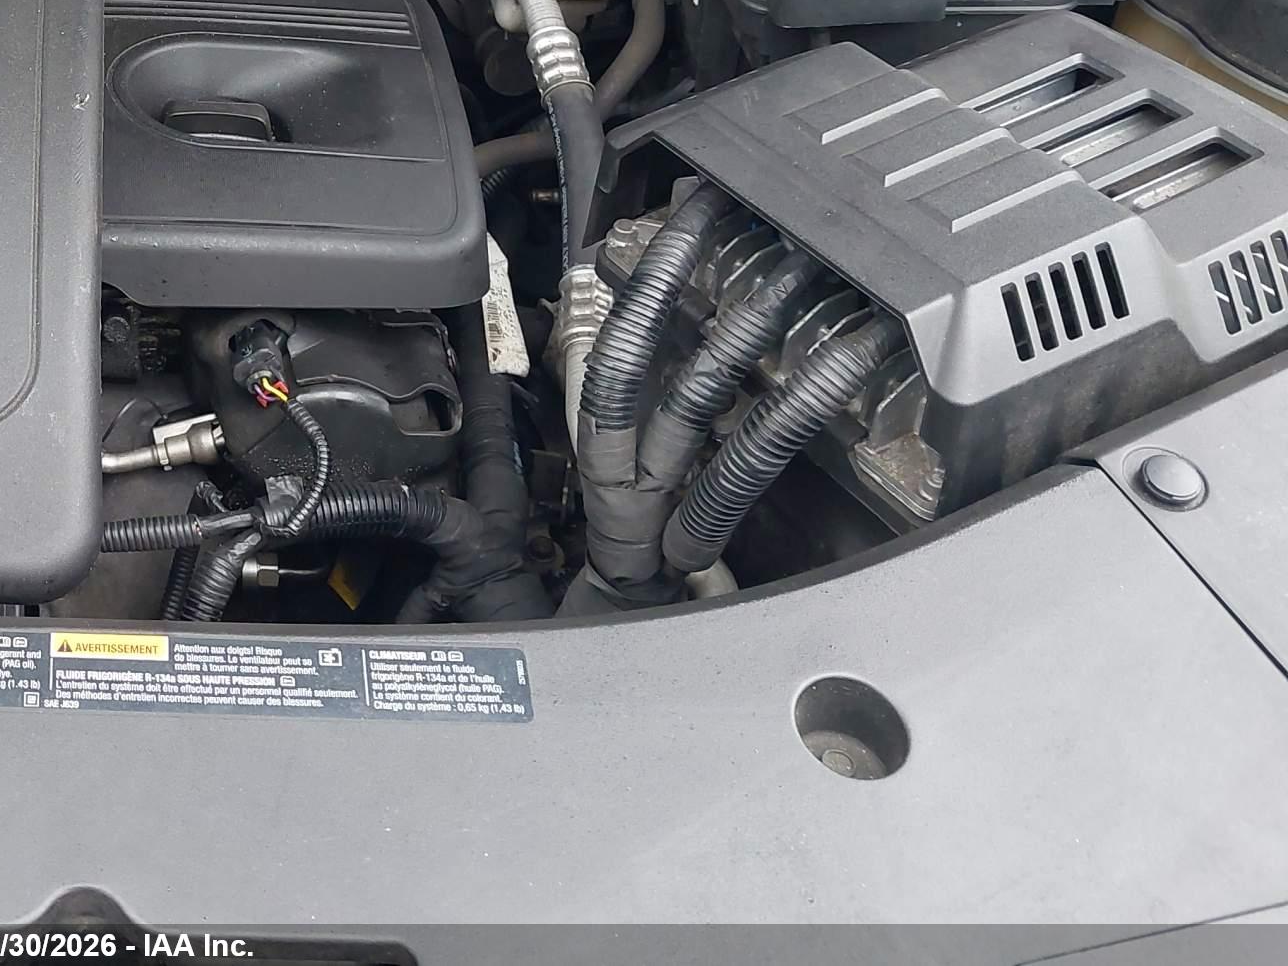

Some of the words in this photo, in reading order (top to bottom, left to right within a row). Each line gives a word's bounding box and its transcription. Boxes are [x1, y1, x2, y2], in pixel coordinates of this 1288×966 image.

[75, 642, 158, 654] AVERTISSEMENT
[26, 650, 42, 659] and
[369, 650, 426, 661] CLIMATISEUR
[2, 659, 20, 669] (PAG
[22, 660, 36, 670] oil).
[56, 670, 86, 680] FLUIDE
[145, 672, 176, 683] R-134a
[177, 674, 201, 684] SOUS
[202, 675, 231, 685] HAUTE
[232, 676, 276, 686] PRESSION
[8, 680, 28, 690] (1.43
[30, 680, 40, 690] lb)
[44, 699, 59, 708] SAE
